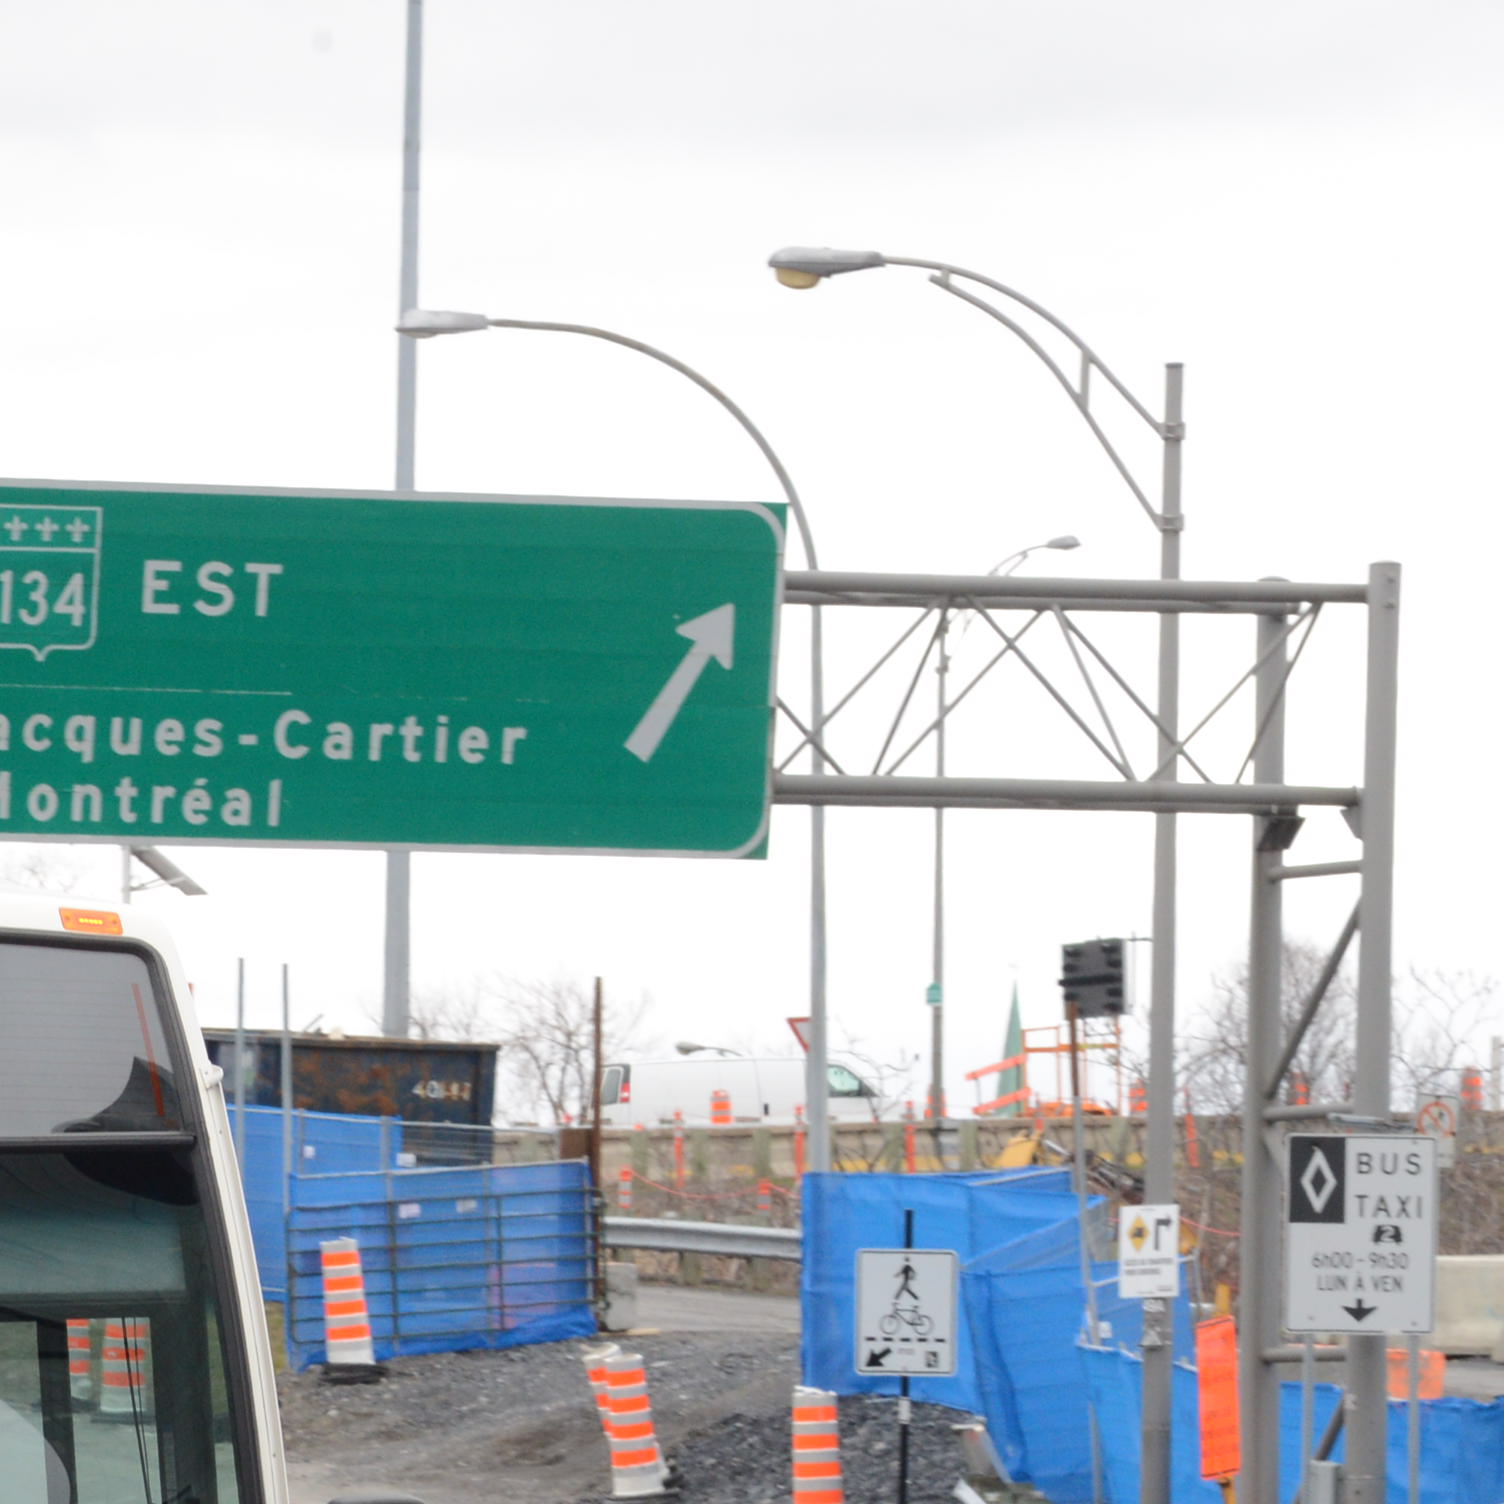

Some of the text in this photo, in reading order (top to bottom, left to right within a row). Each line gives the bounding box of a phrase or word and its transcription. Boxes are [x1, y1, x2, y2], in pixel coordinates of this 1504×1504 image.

[141, 559, 284, 618] EST
[1356, 1152, 1421, 1175] BUS
[1354, 1195, 1423, 1219] TAXI
[1317, 1275, 1347, 1291] LUN
[1371, 1276, 1403, 1292] VEN
